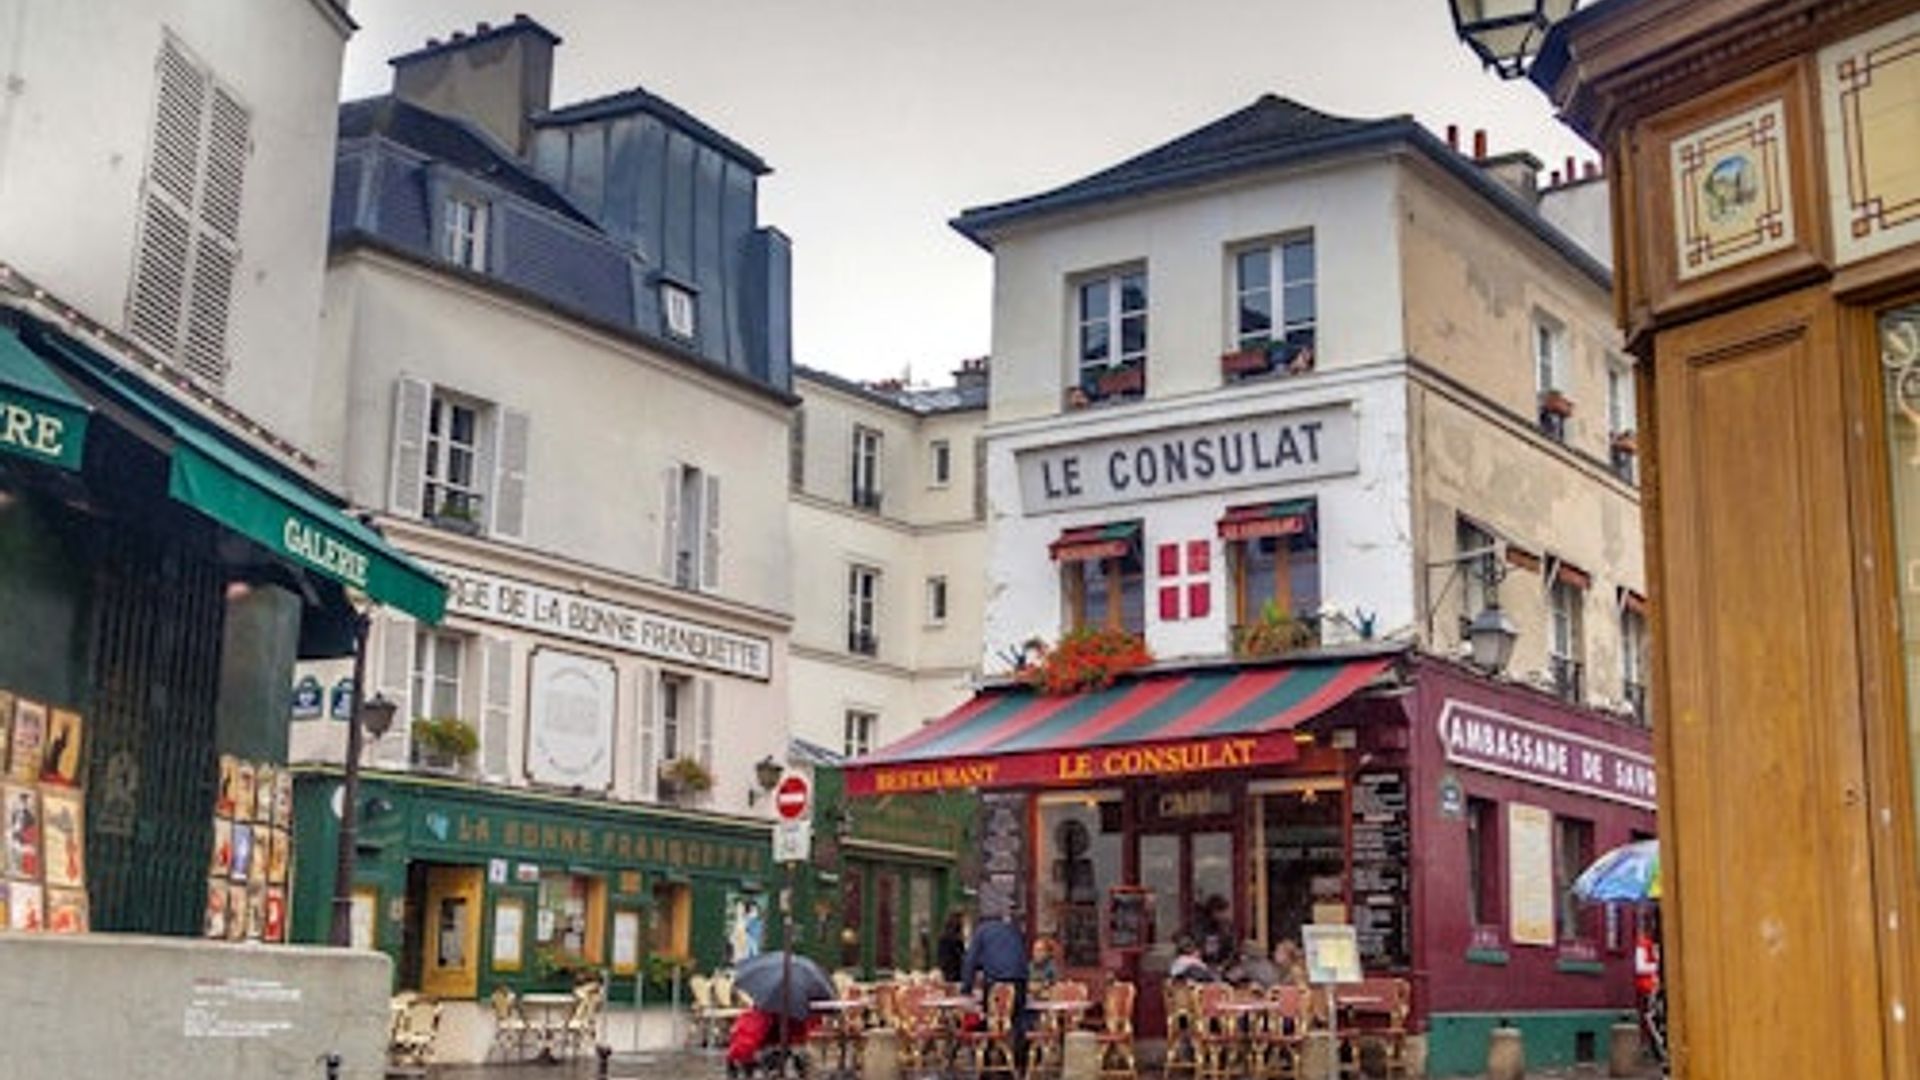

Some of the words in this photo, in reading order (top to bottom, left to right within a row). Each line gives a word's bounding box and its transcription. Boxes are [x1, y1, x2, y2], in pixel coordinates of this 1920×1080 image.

[1042, 457, 1082, 499] LE
[1108, 421, 1322, 490] CONSULAT
[284, 517, 369, 587] GALERIE
[499, 586, 526, 617] DE
[534, 594, 561, 626] LA
[568, 601, 637, 642] BONNE
[641, 619, 762, 671] FRANQUETTE
[1059, 754, 1092, 779] LE
[1103, 739, 1257, 775] CONSULAT
[1451, 716, 1568, 776] AMBASSADE
[1581, 750, 1603, 783] DE
